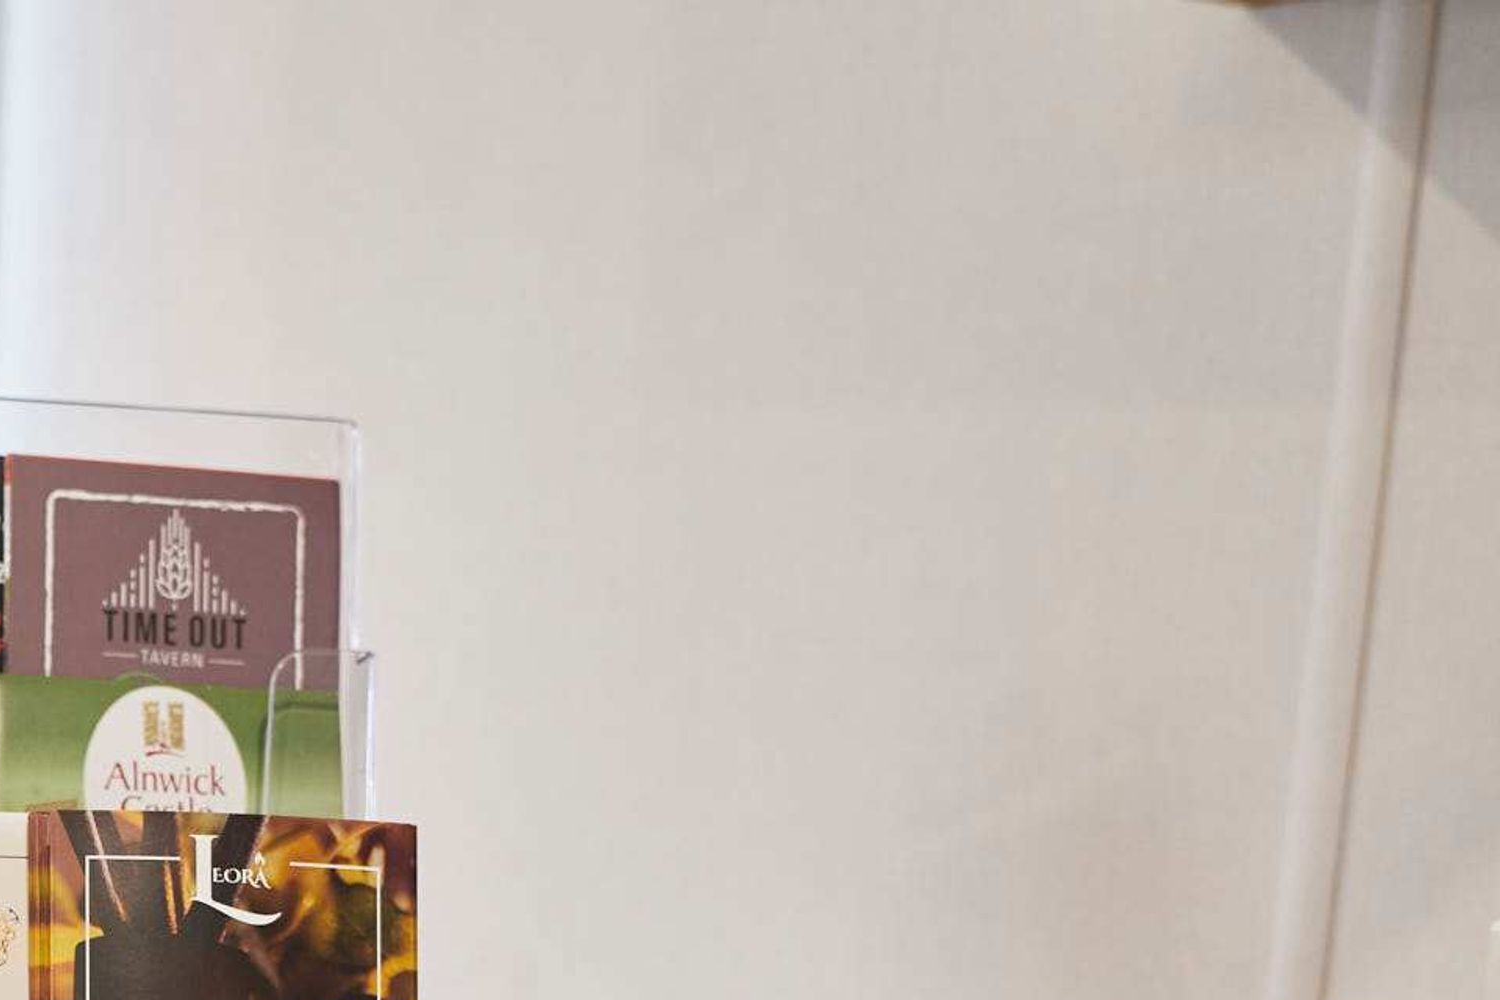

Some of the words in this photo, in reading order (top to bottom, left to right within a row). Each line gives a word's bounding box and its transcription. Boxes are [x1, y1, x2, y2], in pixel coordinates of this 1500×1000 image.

[104, 609, 177, 647] TIME
[189, 615, 246, 650] OUT
[140, 650, 205, 668] TAVERN
[104, 761, 226, 797] Alnwick
